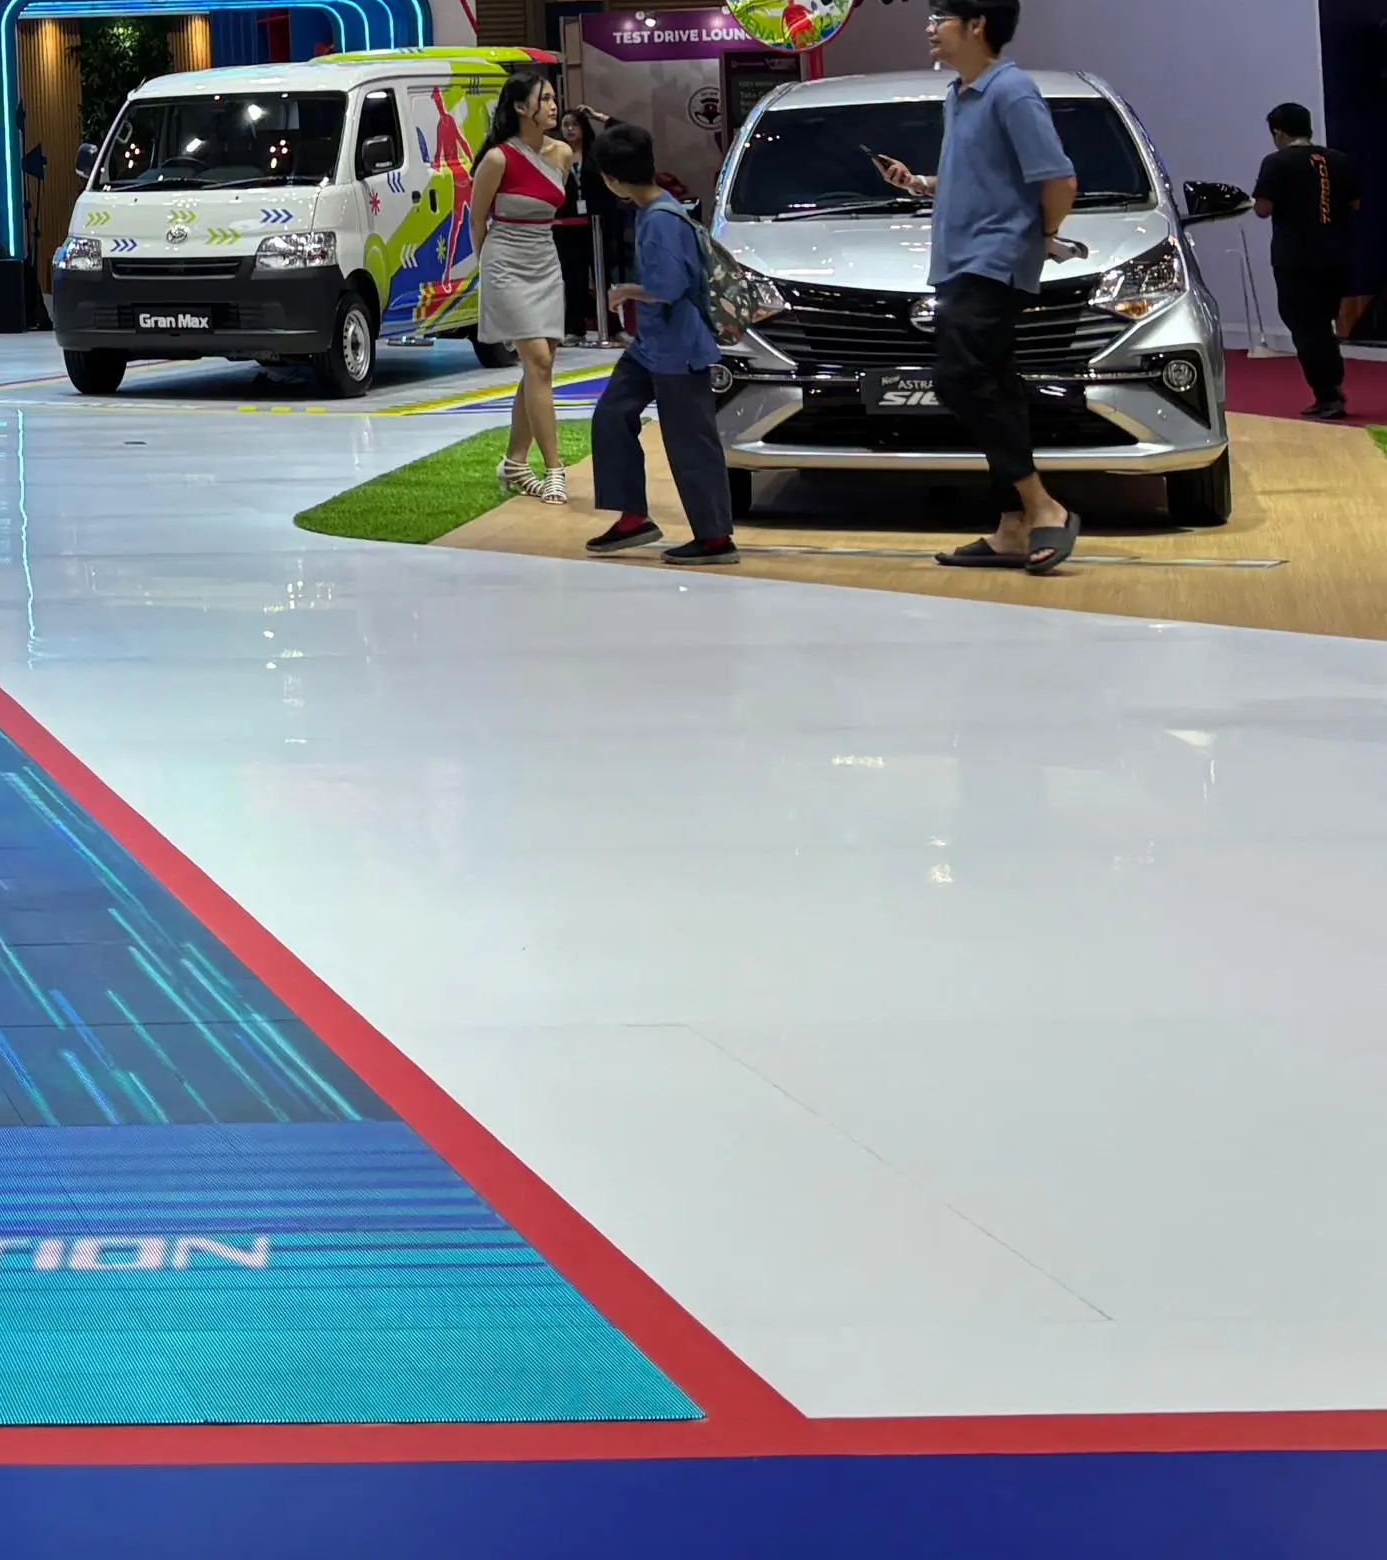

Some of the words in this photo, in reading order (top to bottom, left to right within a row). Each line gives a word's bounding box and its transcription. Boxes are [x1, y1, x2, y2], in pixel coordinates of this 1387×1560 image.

[613, 30, 650, 44] TEST
[654, 29, 699, 42] DRIVE
[139, 313, 176, 328] Gran
[177, 313, 209, 328] Max
